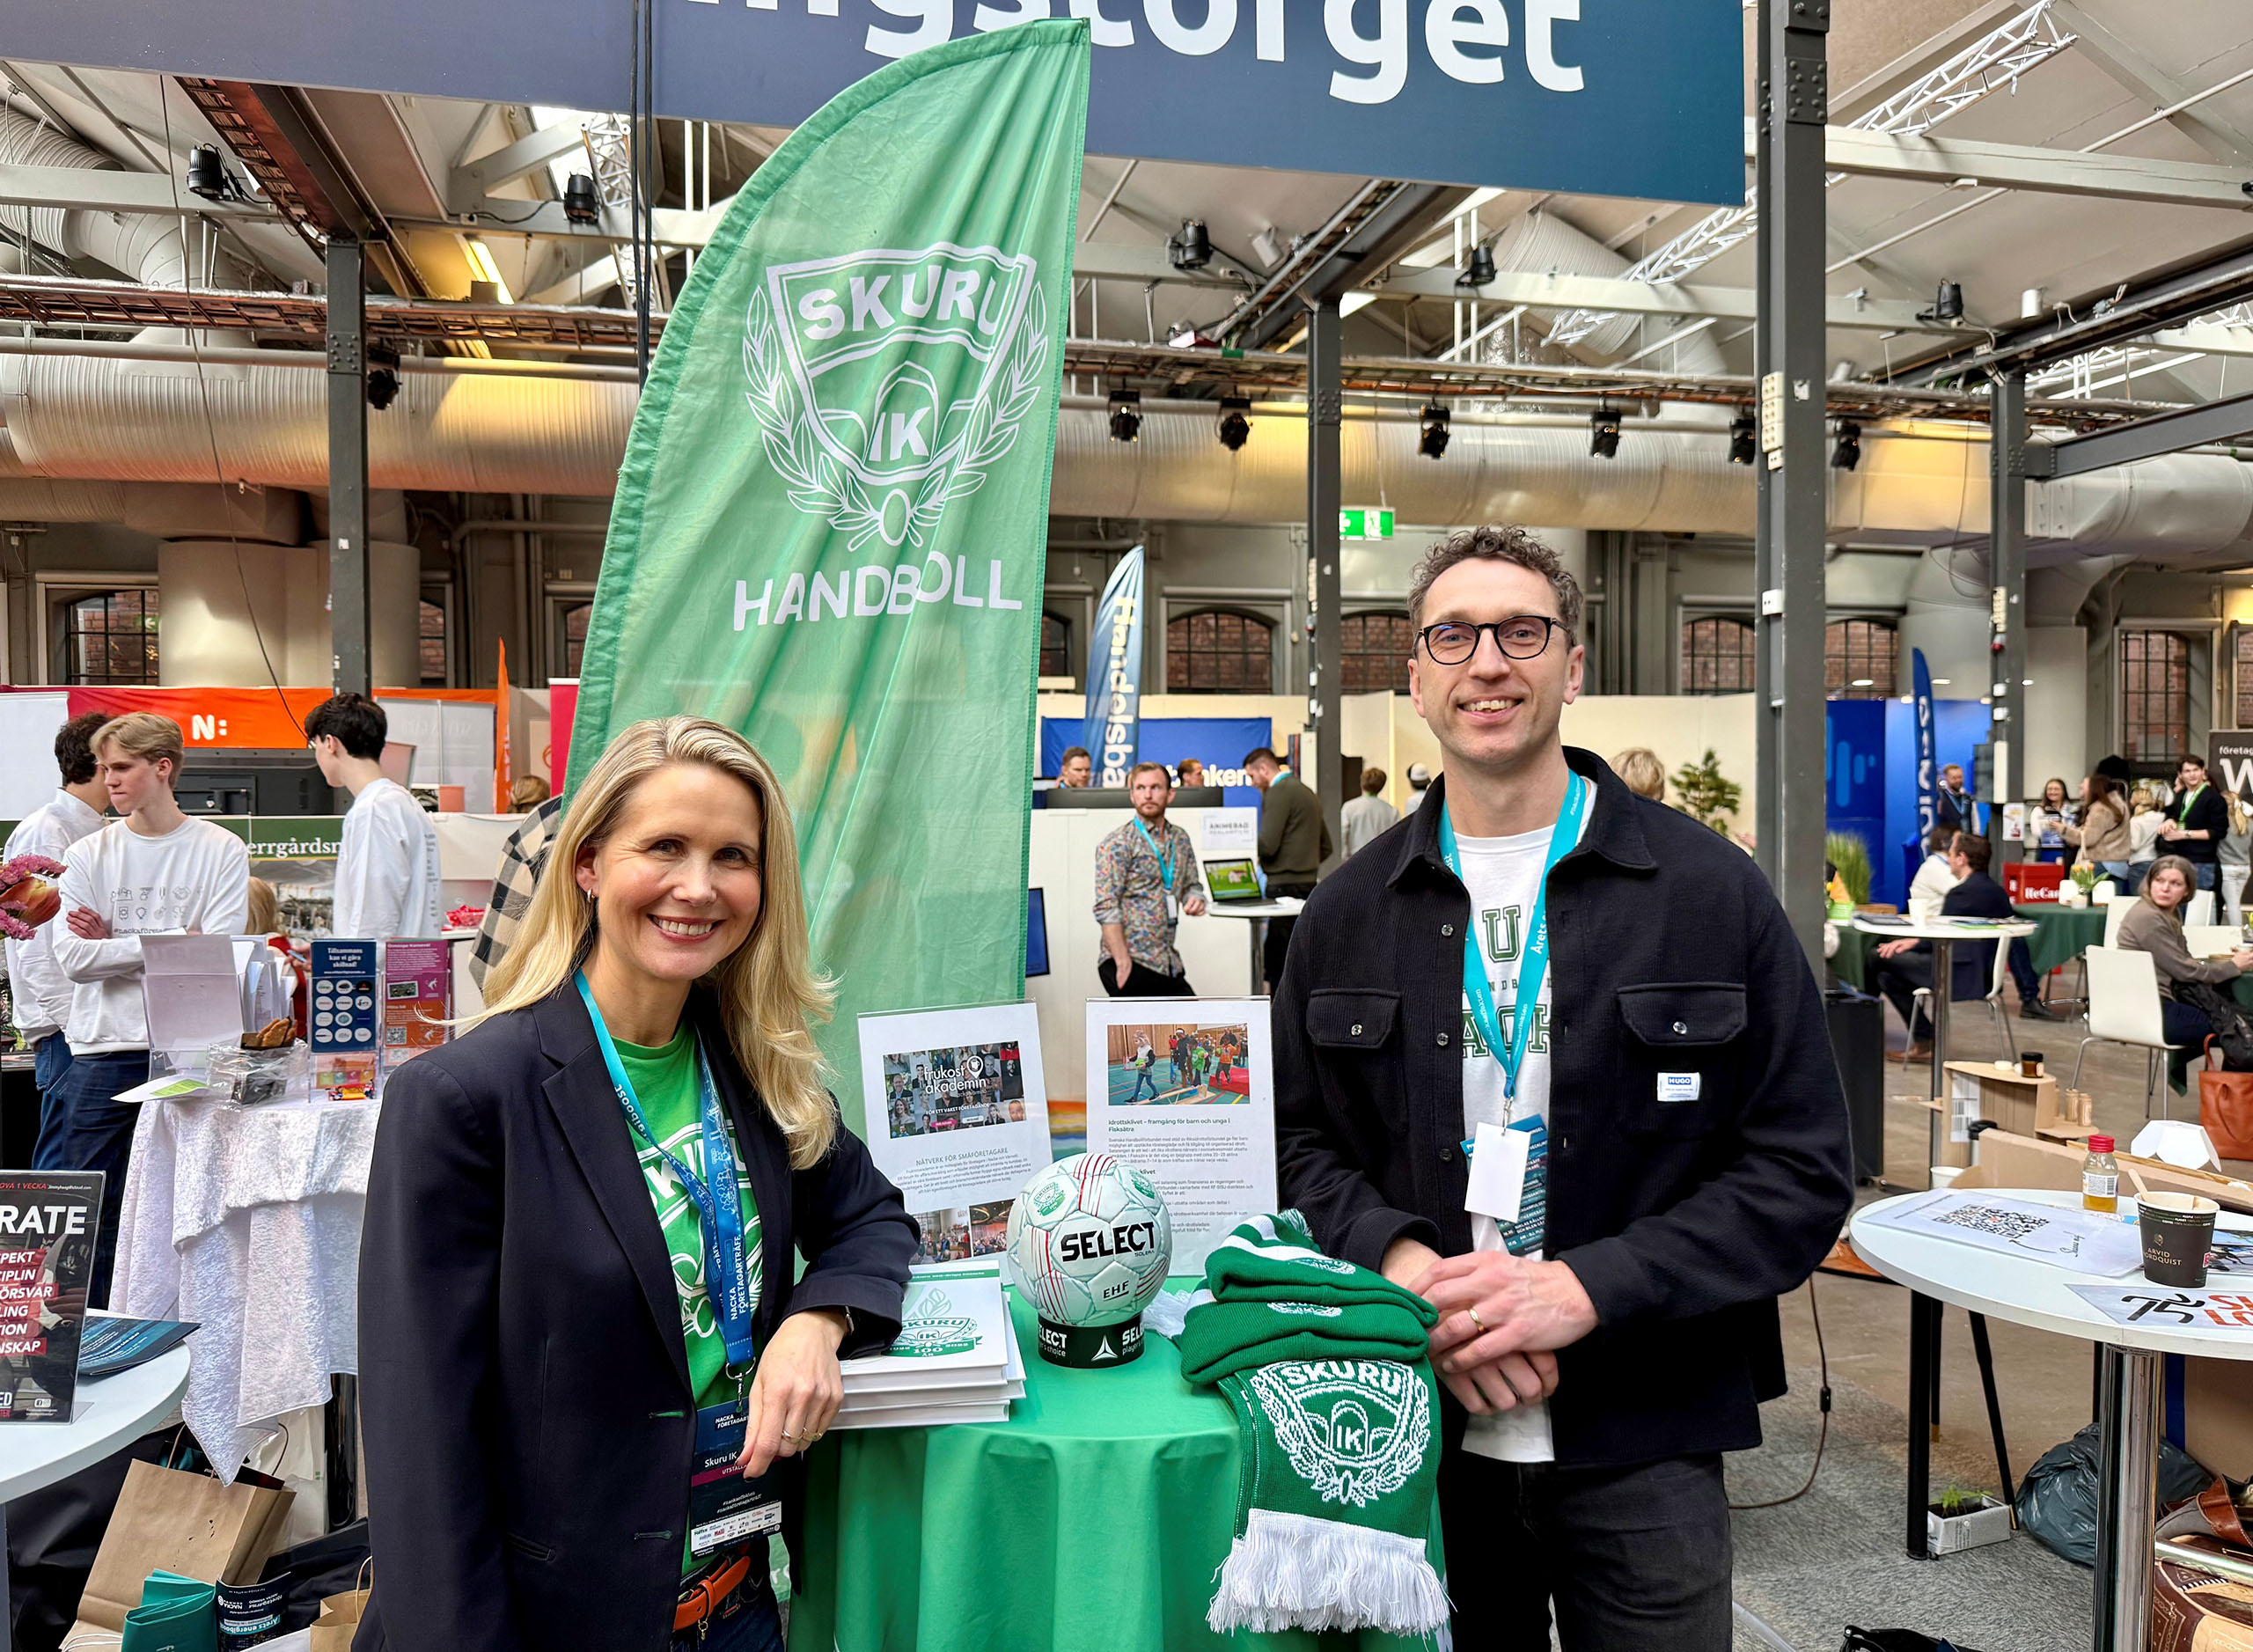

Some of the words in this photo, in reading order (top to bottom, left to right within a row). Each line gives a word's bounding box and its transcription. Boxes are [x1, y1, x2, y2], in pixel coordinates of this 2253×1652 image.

[798, 265, 1010, 340] SKURU
[869, 407, 931, 462] IK
[733, 551, 1023, 631] HANDBOLL
[1103, 597, 1137, 789] Handelsba
[924, 1064, 965, 1081] frukost
[925, 1077, 987, 1094] akademin
[915, 1156, 943, 1166] NÄTVERK
[944, 1154, 957, 1163] FÖR
[958, 1148, 1008, 1161] SMÅFÖRETAGARE
[0, 1205, 88, 1234] RATE
[1060, 1222, 1155, 1262] SELECT
[2147, 1247, 2170, 1258] ARVID
[0, 1252, 35, 1264] PEKT
[733, 1236, 746, 1314] FÖRETAGARTRÄFF
[1103, 1280, 1130, 1299] EHF
[729, 1287, 738, 1320] NACKA
[1047, 1344, 1067, 1357] choice
[1281, 1360, 1402, 1395] SKURU
[716, 1413, 734, 1424] NACKA
[1336, 1425, 1363, 1452] IK
[704, 1455, 728, 1468] Skuru
[729, 1451, 738, 1461] IK
